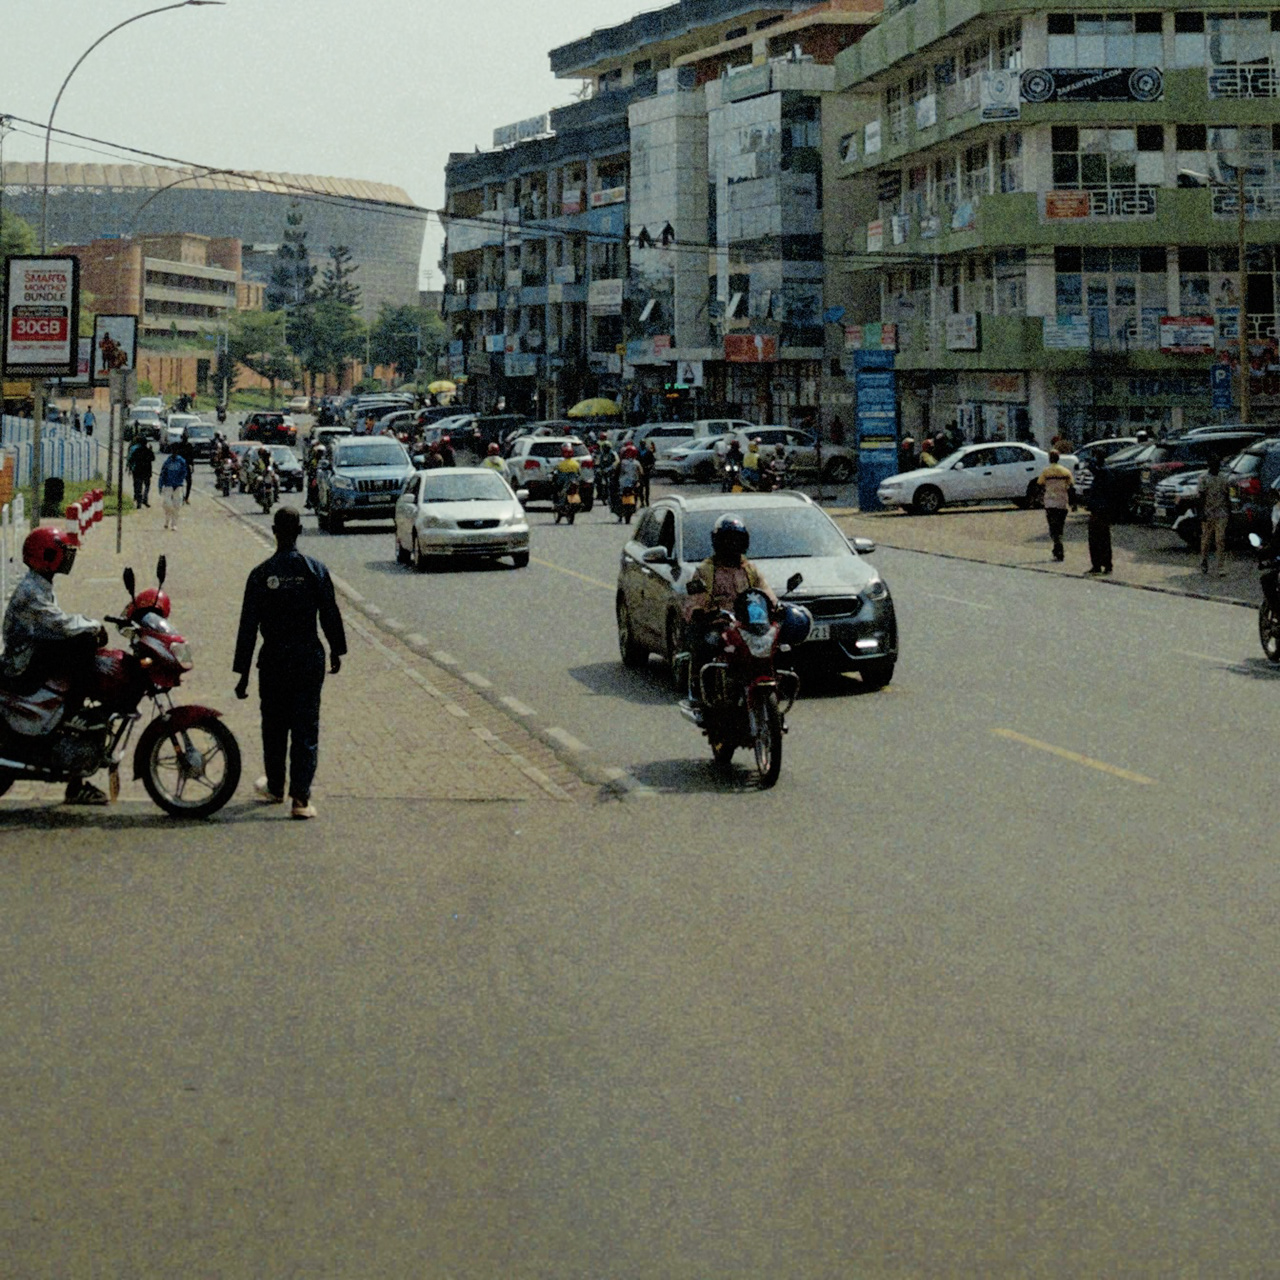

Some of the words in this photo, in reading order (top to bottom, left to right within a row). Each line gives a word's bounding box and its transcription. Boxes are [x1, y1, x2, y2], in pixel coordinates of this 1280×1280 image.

[24, 292, 66, 301] BUNDLE
[16, 320, 60, 334] 30GB
[1215, 369, 1226, 383] P
